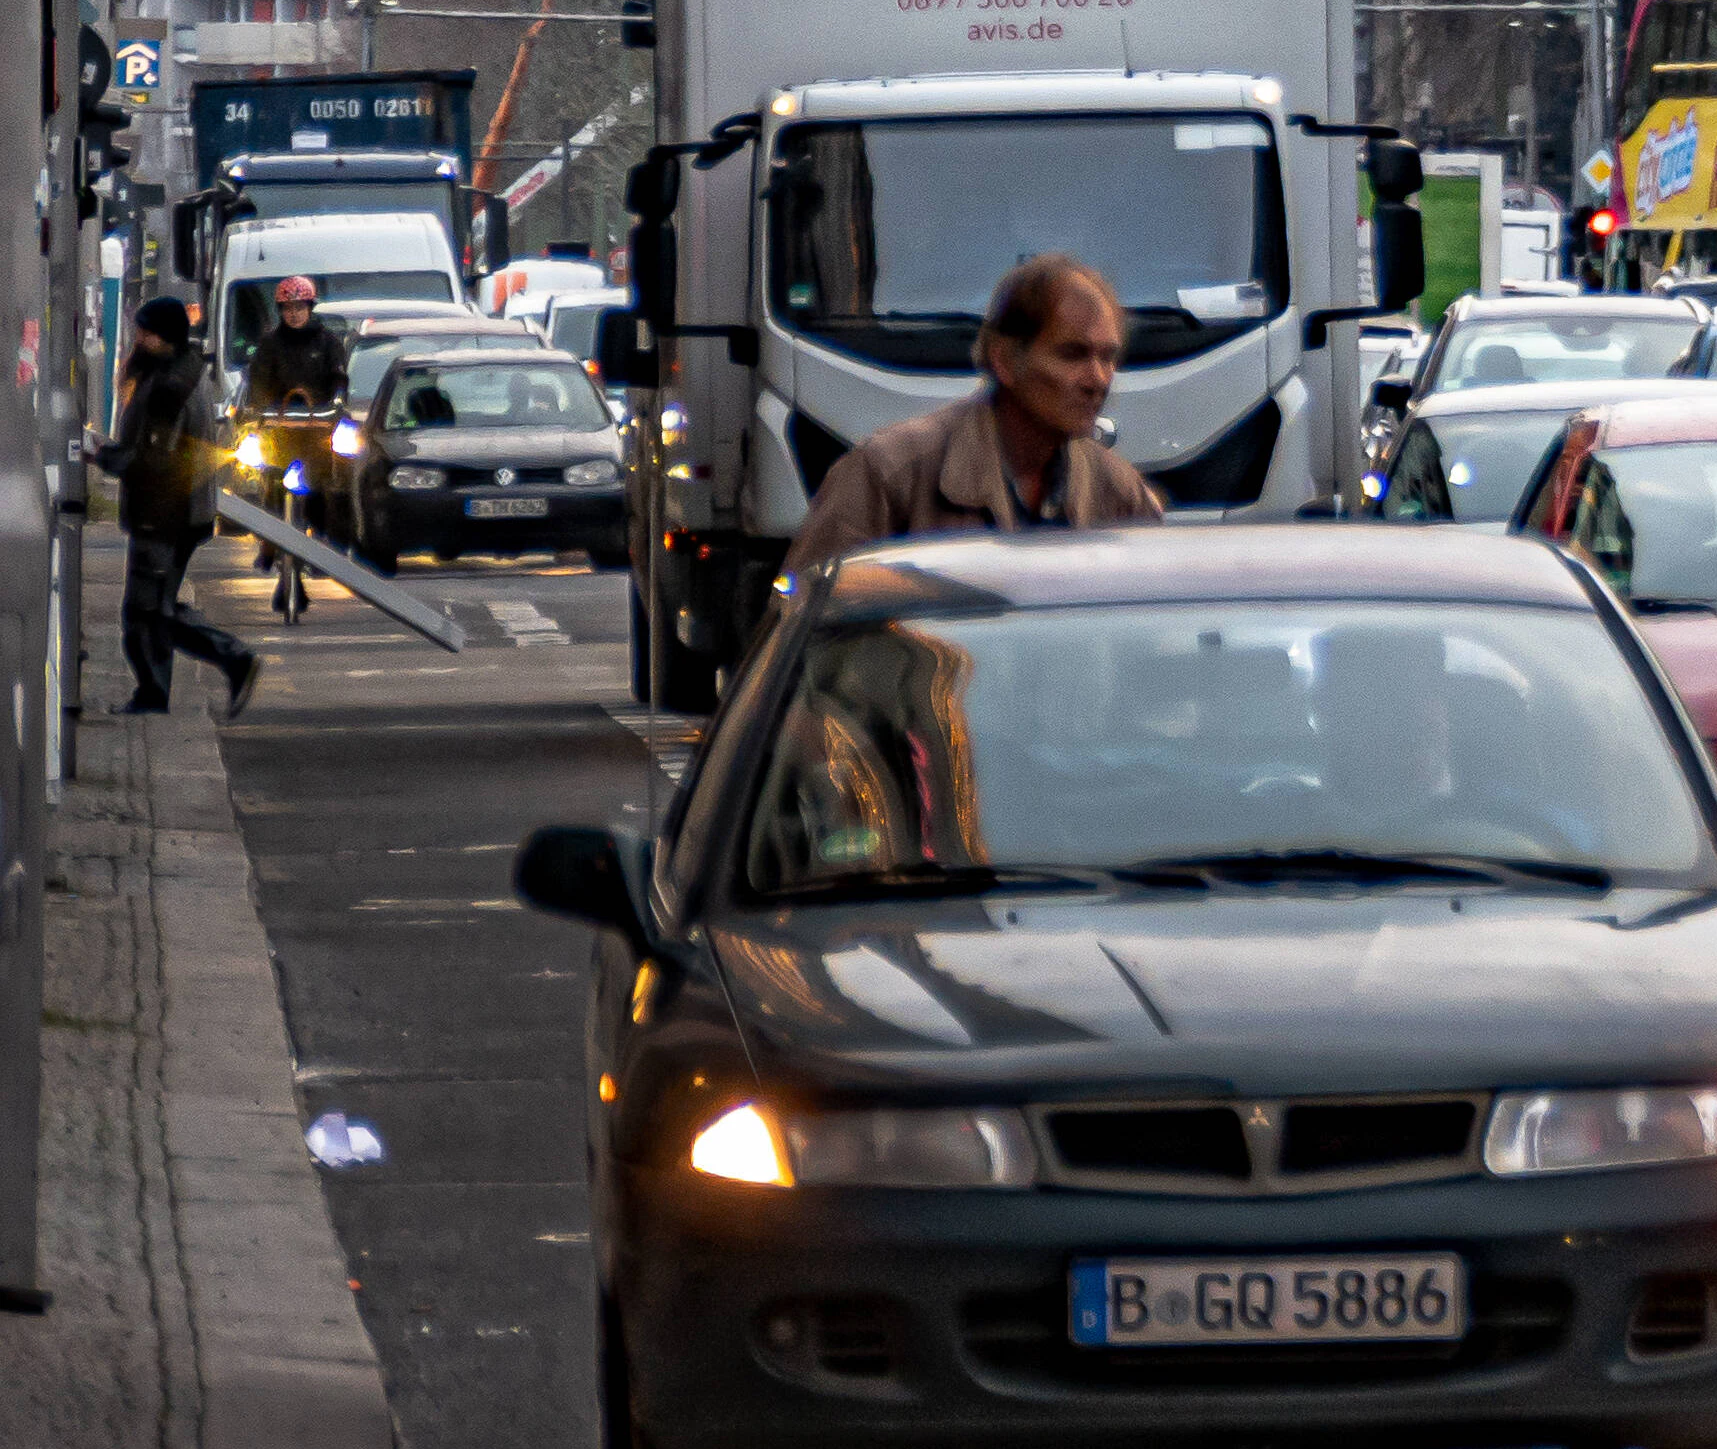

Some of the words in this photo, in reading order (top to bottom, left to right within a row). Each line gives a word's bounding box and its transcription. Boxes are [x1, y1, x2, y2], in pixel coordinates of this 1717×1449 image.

[967, 17, 1063, 41] avis.de
[224, 103, 249, 122] 34
[1111, 1273, 1149, 1332] B
[1195, 1271, 1275, 1330] GQ
[1293, 1268, 1448, 1330] 5886
